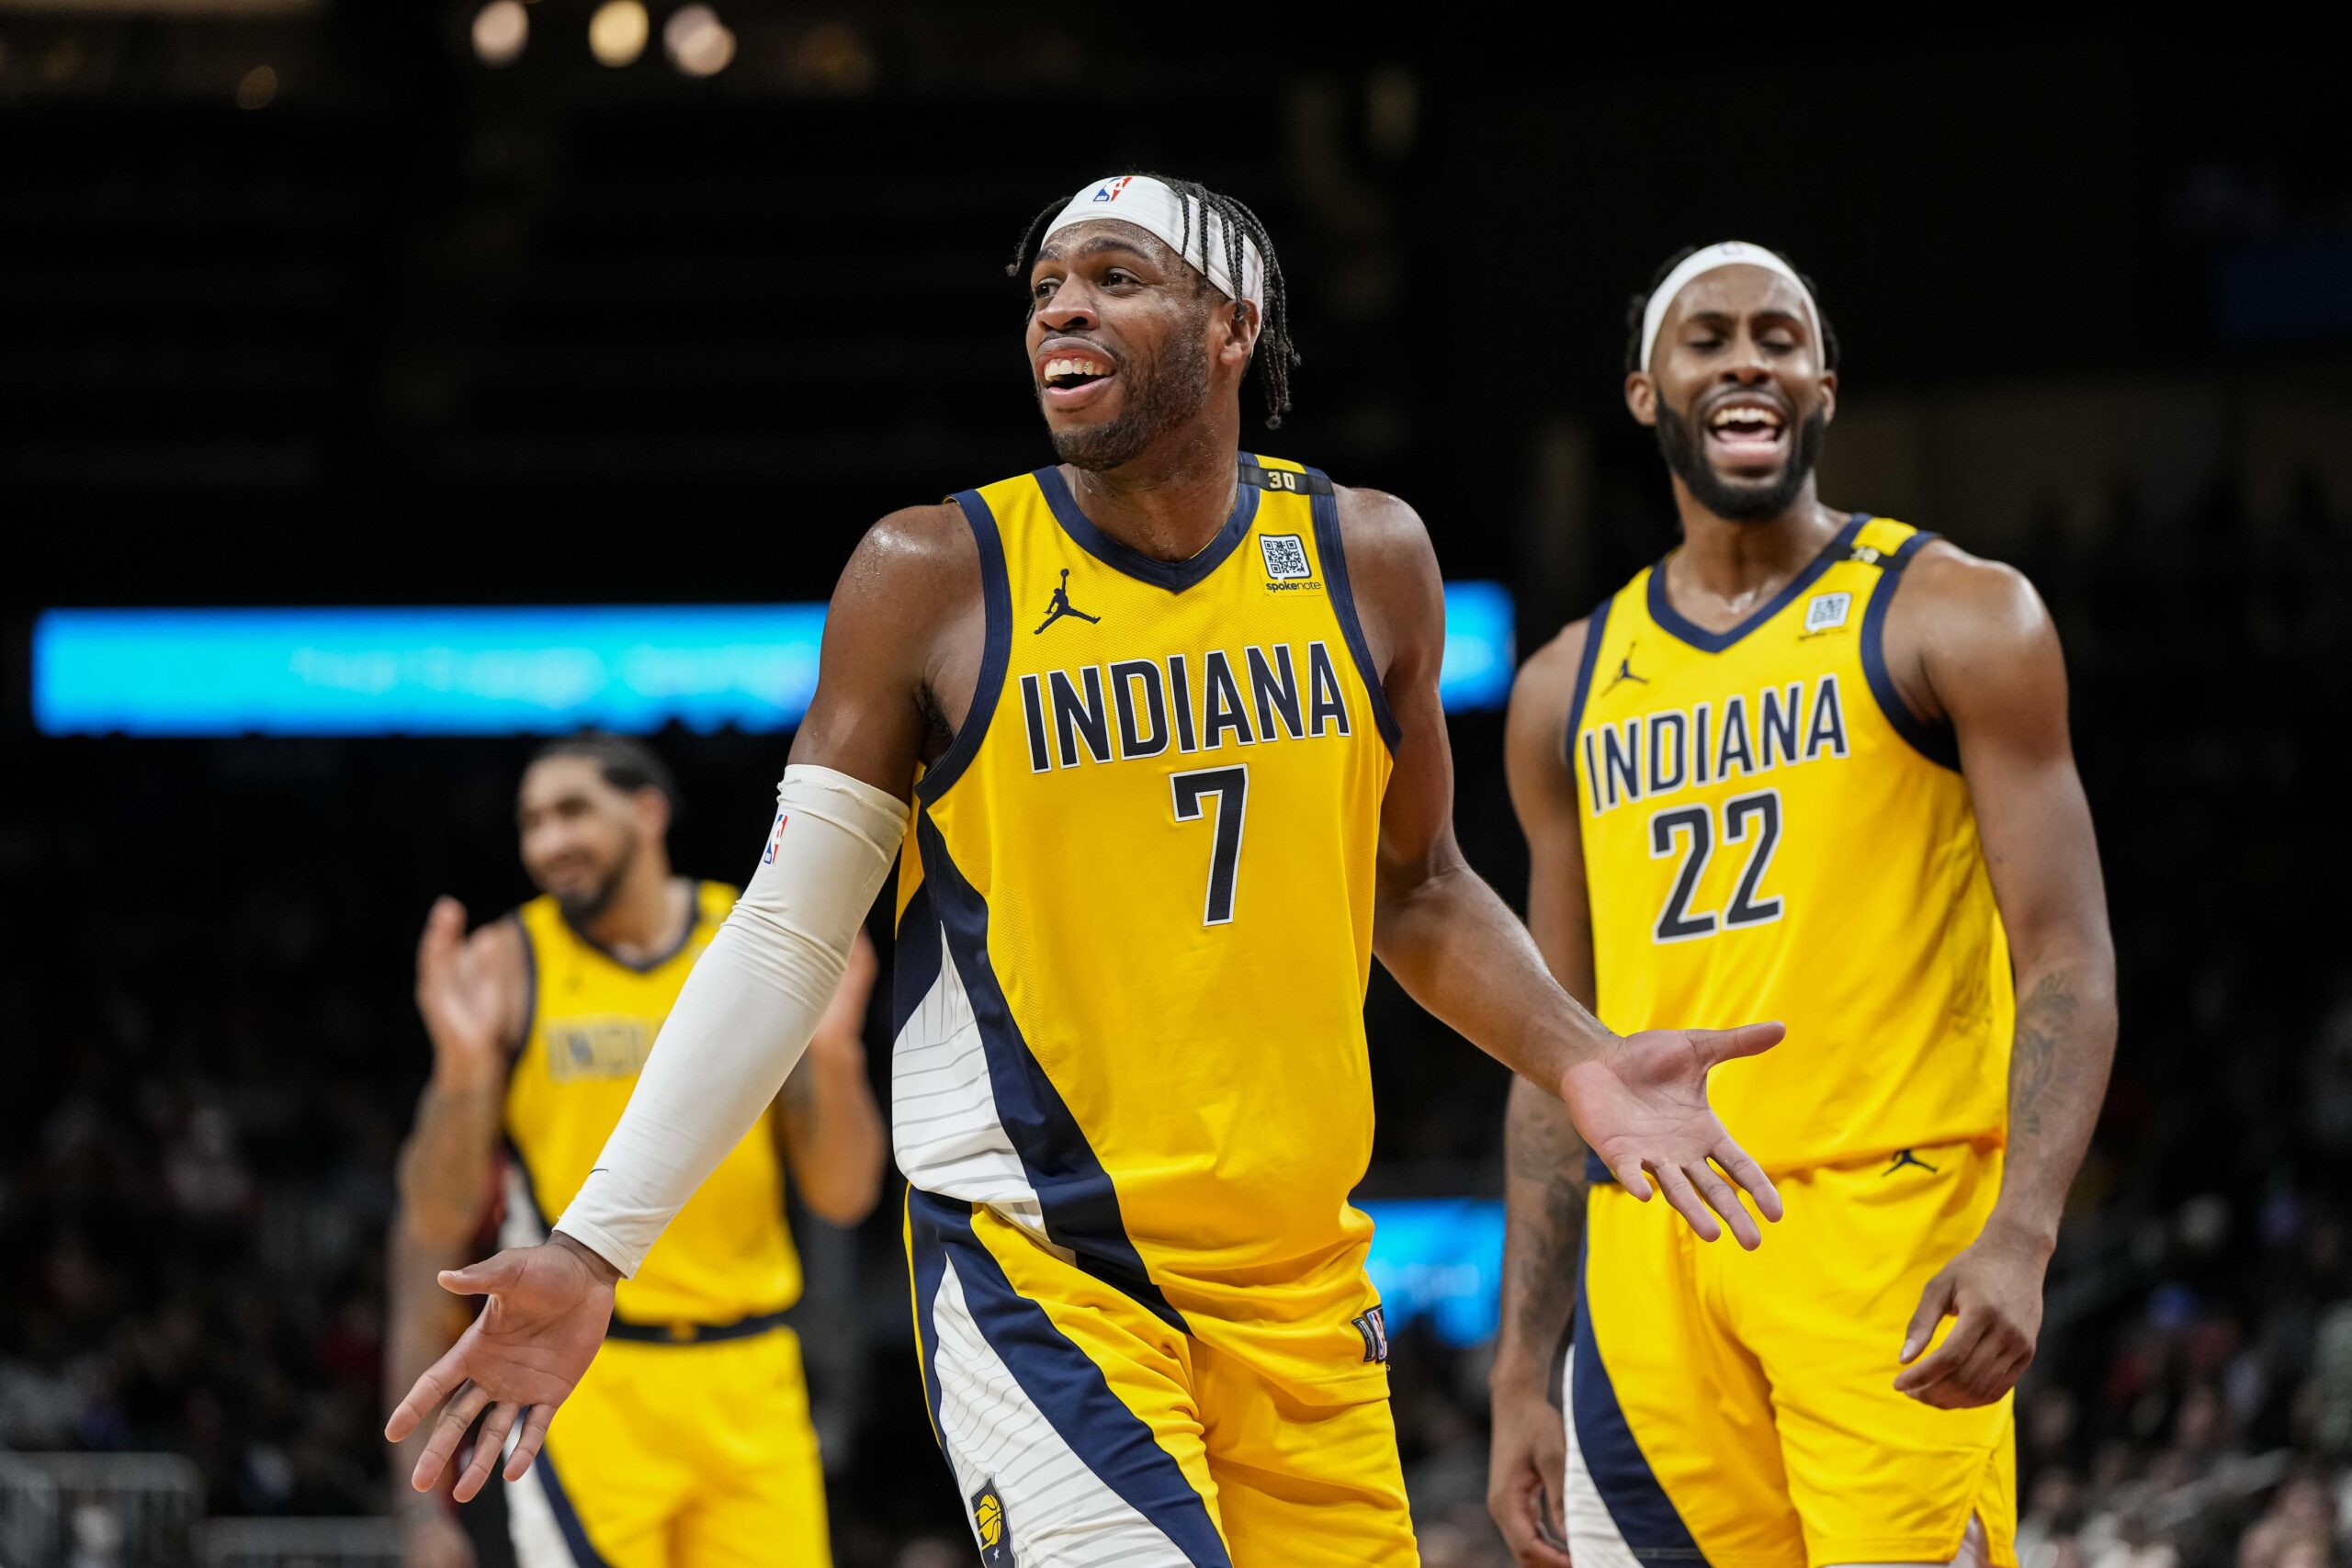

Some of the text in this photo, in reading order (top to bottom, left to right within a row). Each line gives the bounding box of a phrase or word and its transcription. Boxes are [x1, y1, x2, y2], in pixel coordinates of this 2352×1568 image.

[1268, 471, 1295, 491] 30
[1266, 581, 1321, 592] spokenote
[1020, 642, 1351, 773] INDIANA
[1583, 675, 1849, 815] INDIANA
[1169, 763, 1249, 926] 7
[1648, 788, 1784, 944] 22
